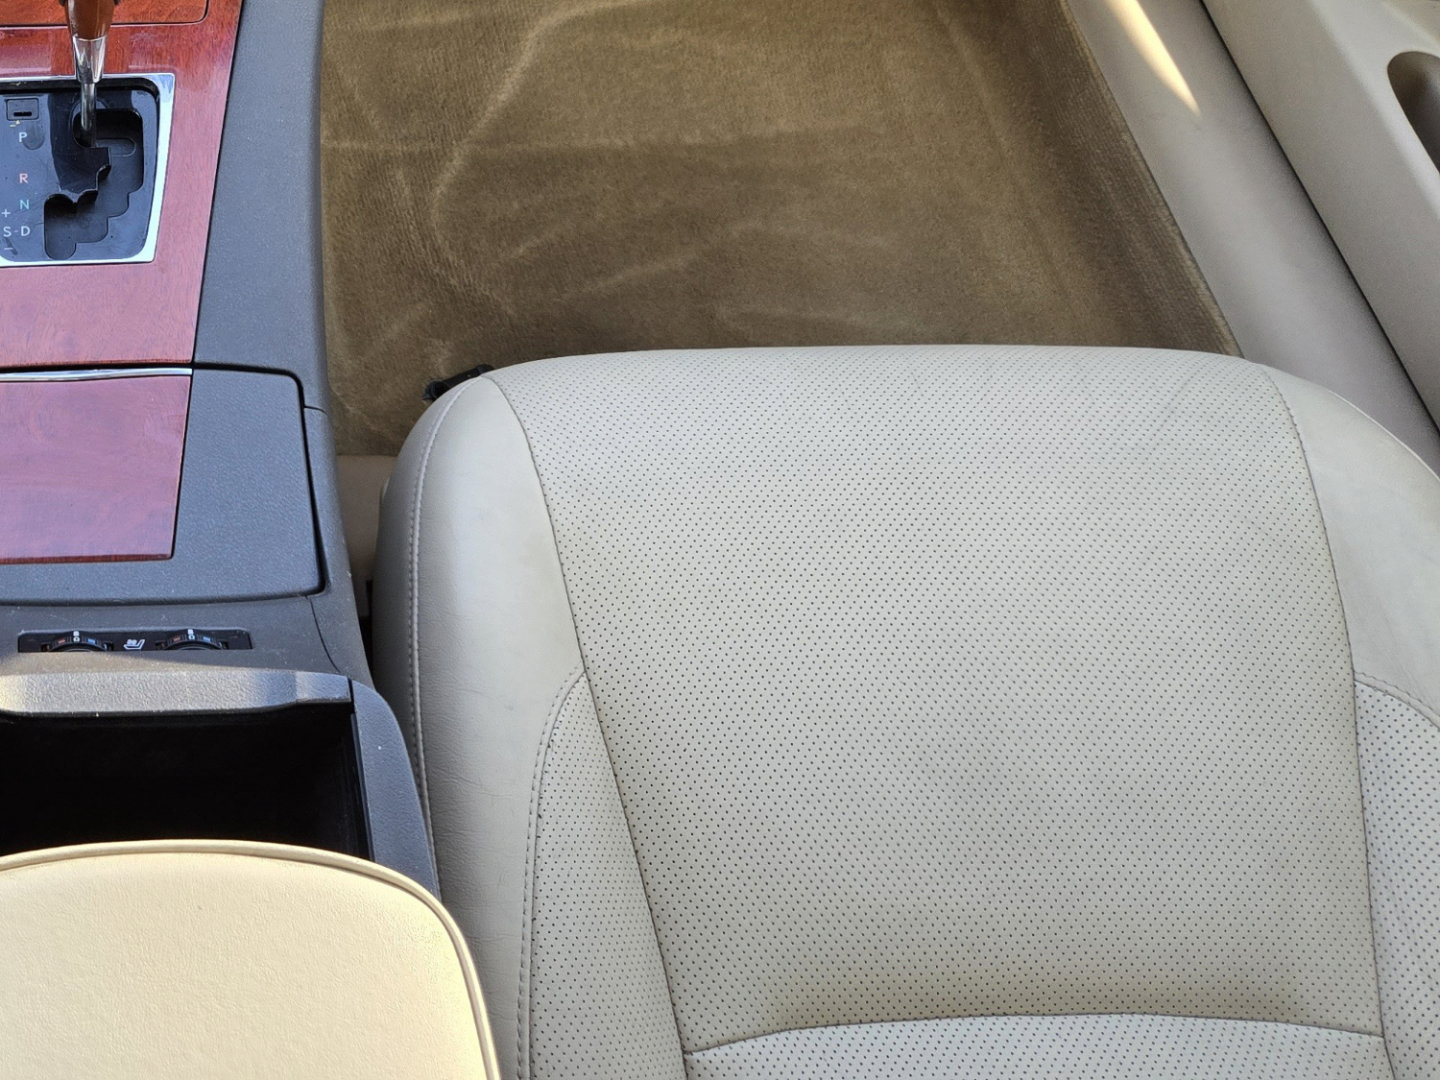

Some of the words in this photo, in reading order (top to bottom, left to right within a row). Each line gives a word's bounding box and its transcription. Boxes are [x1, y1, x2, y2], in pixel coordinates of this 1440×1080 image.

[19, 132, 27, 143] P
[19, 173, 29, 184] R
[20, 200, 30, 210] N
